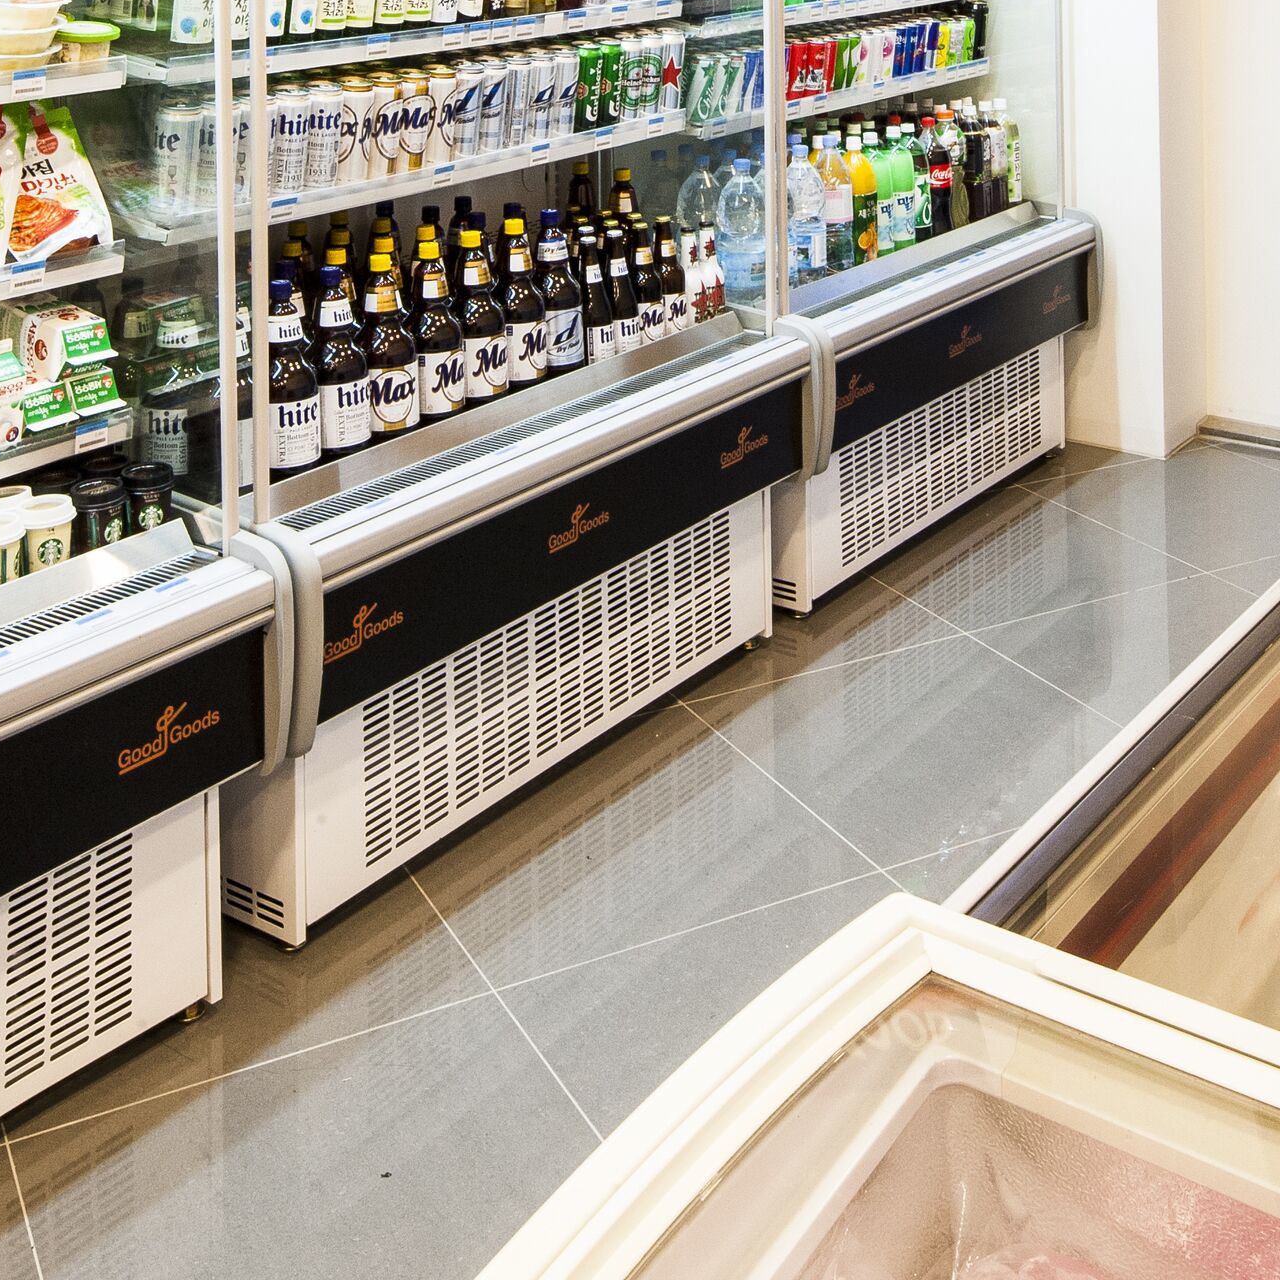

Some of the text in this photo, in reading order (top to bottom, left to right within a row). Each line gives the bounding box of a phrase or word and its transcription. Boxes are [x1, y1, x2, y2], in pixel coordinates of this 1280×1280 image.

[20, 158, 55, 180] 가집
[21, 173, 77, 195] 맛김치
[278, 324, 302, 339] hite
[368, 376, 417, 408] Max
[278, 399, 319, 429] hite
[278, 434, 286, 463] EXTRA
[720, 433, 769, 465] Good Goods
[548, 511, 610, 549] Good Goods
[324, 610, 404, 659] Good Goods
[118, 709, 220, 769] Good Goods
